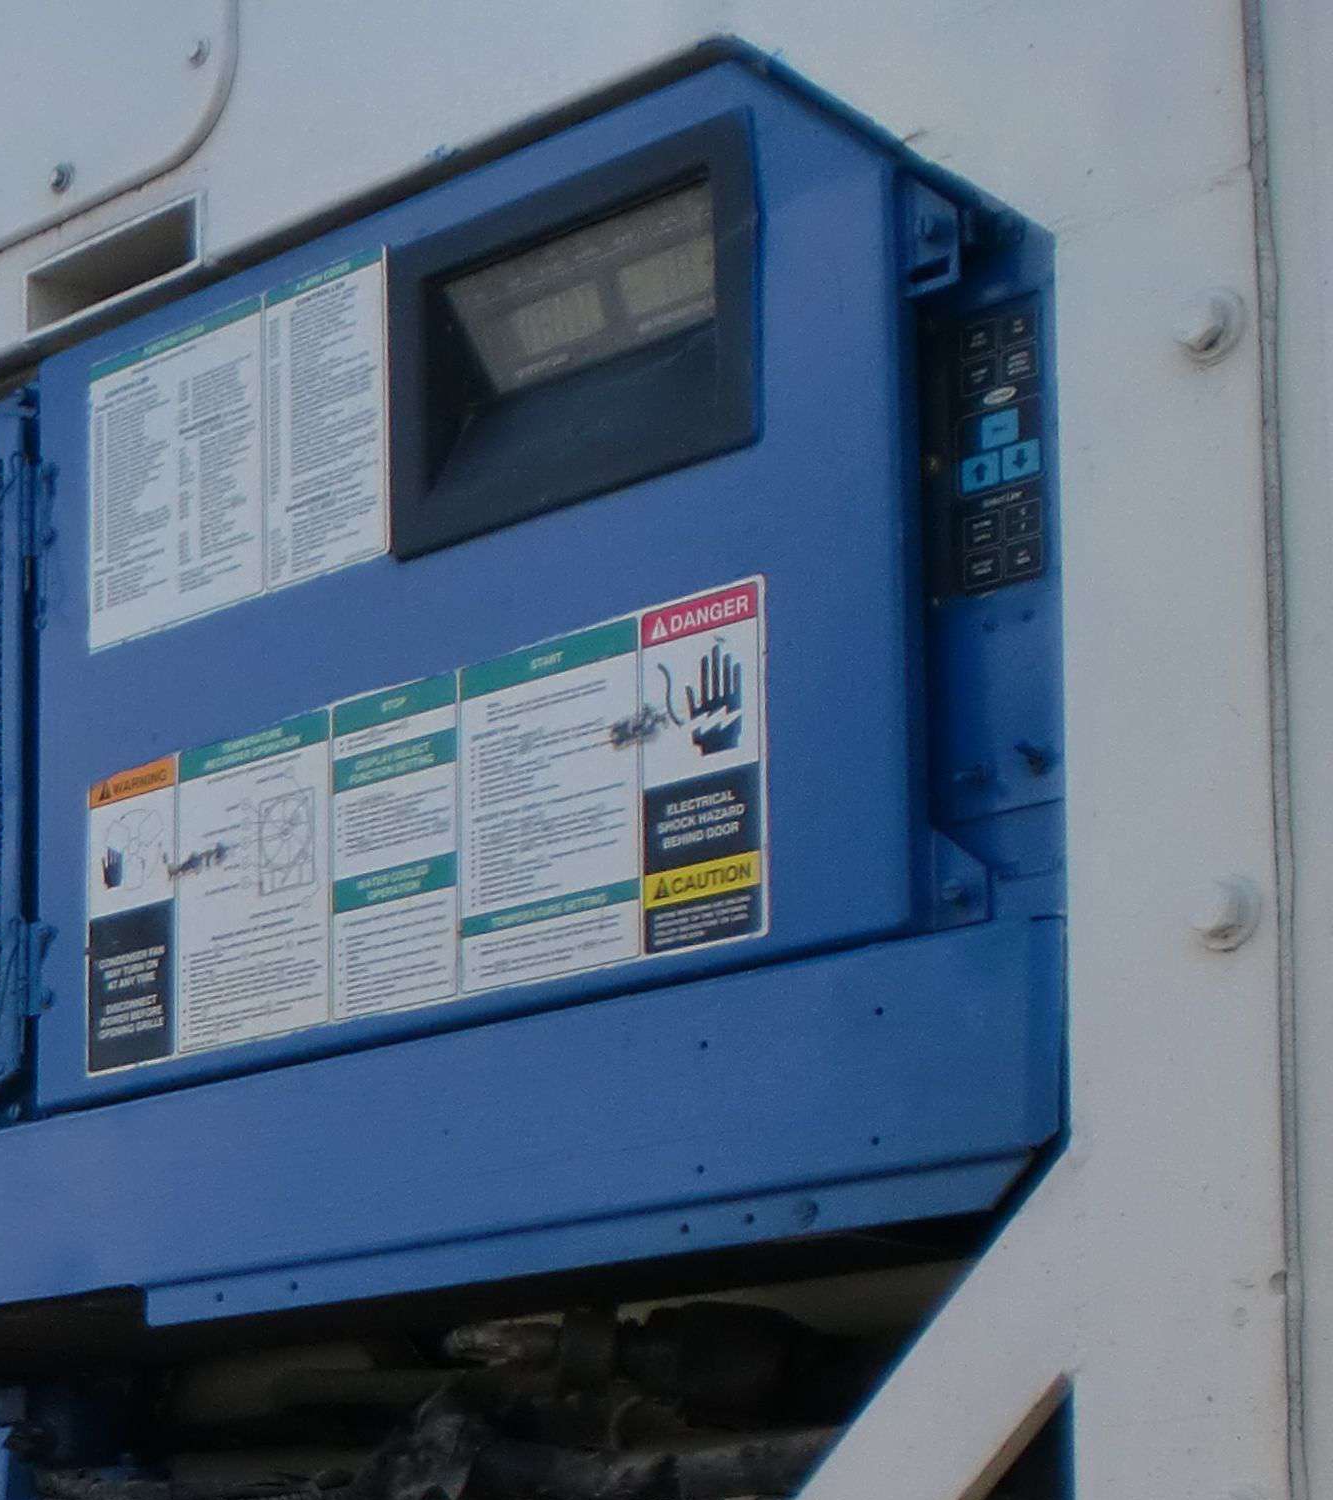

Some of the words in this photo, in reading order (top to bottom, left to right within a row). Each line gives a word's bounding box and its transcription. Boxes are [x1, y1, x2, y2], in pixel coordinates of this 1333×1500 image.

[670, 594, 749, 633] DANGER
[531, 651, 565, 670] START
[114, 768, 168, 795] WARNING
[666, 790, 736, 816] ELECTRICAL
[658, 816, 698, 834] SHOCK
[699, 803, 745, 824] HAZARD
[663, 829, 705, 849] BEHIND
[706, 821, 740, 840] DOOR
[671, 863, 752, 894] CAUTION
